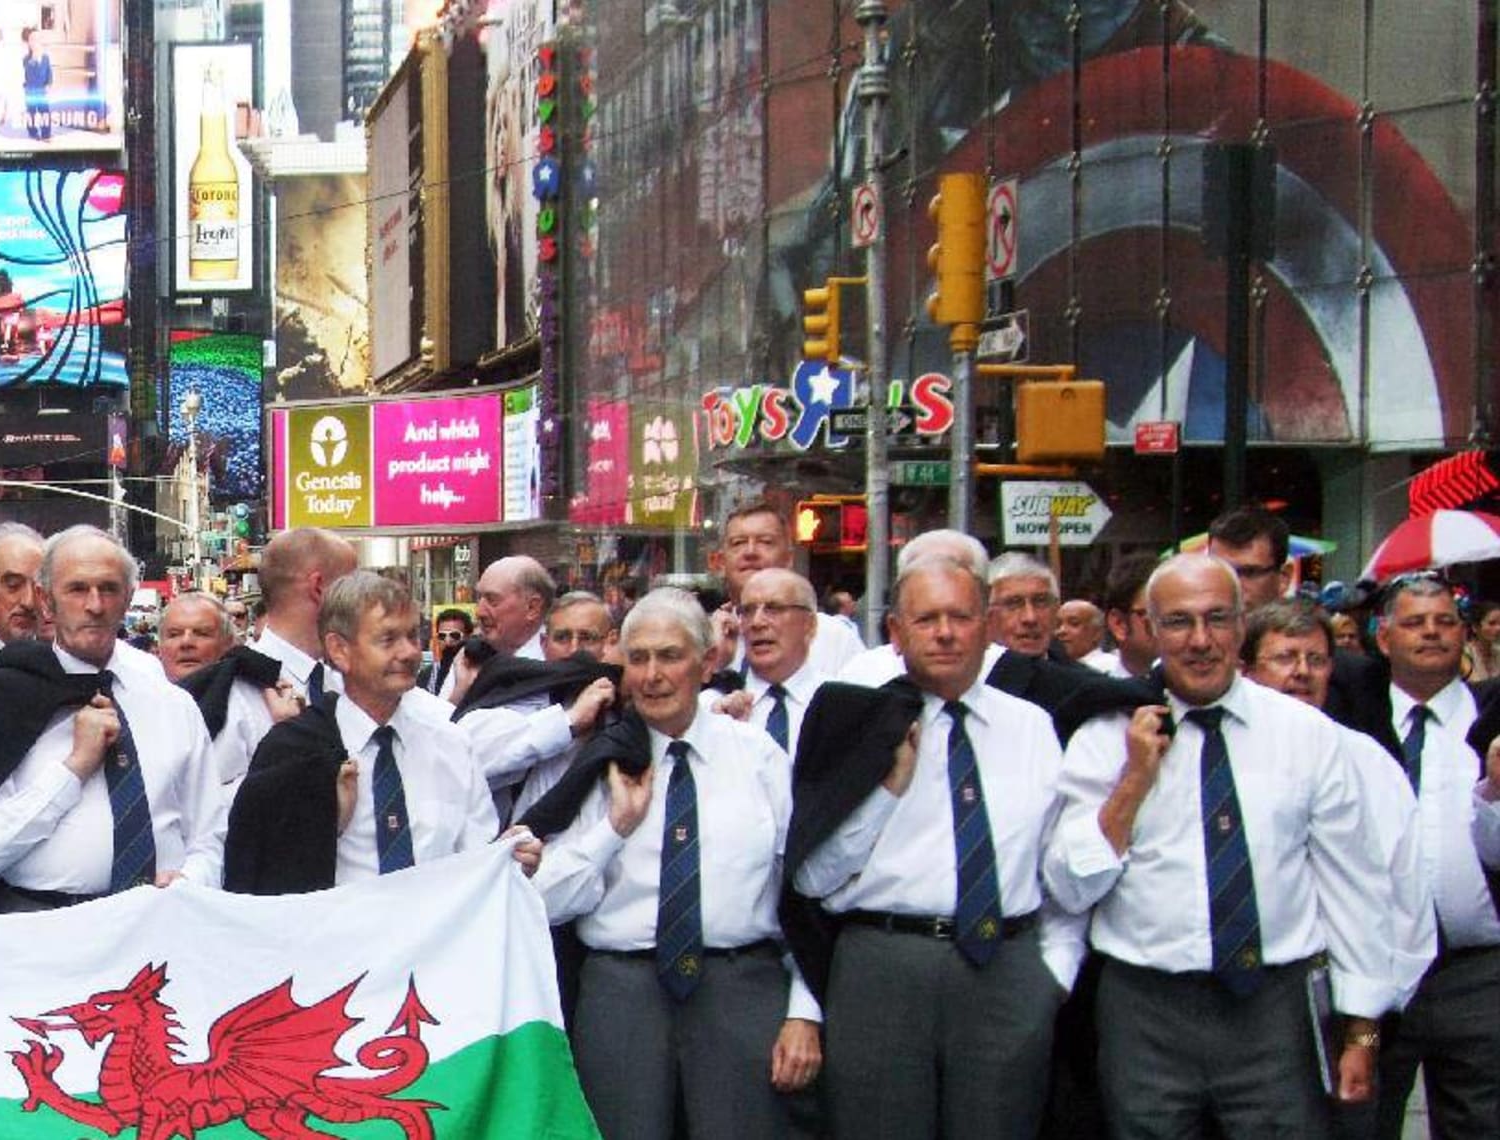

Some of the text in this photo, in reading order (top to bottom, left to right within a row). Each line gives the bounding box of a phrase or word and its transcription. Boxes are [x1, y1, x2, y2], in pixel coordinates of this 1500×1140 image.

[789, 358, 857, 450] R
[403, 417, 480, 443] And which
[387, 448, 490, 480] product might
[295, 471, 362, 492] Genesis
[304, 493, 356, 519] Today
[1009, 494, 1097, 516] SUBWAY
[1016, 522, 1049, 535] NOW
